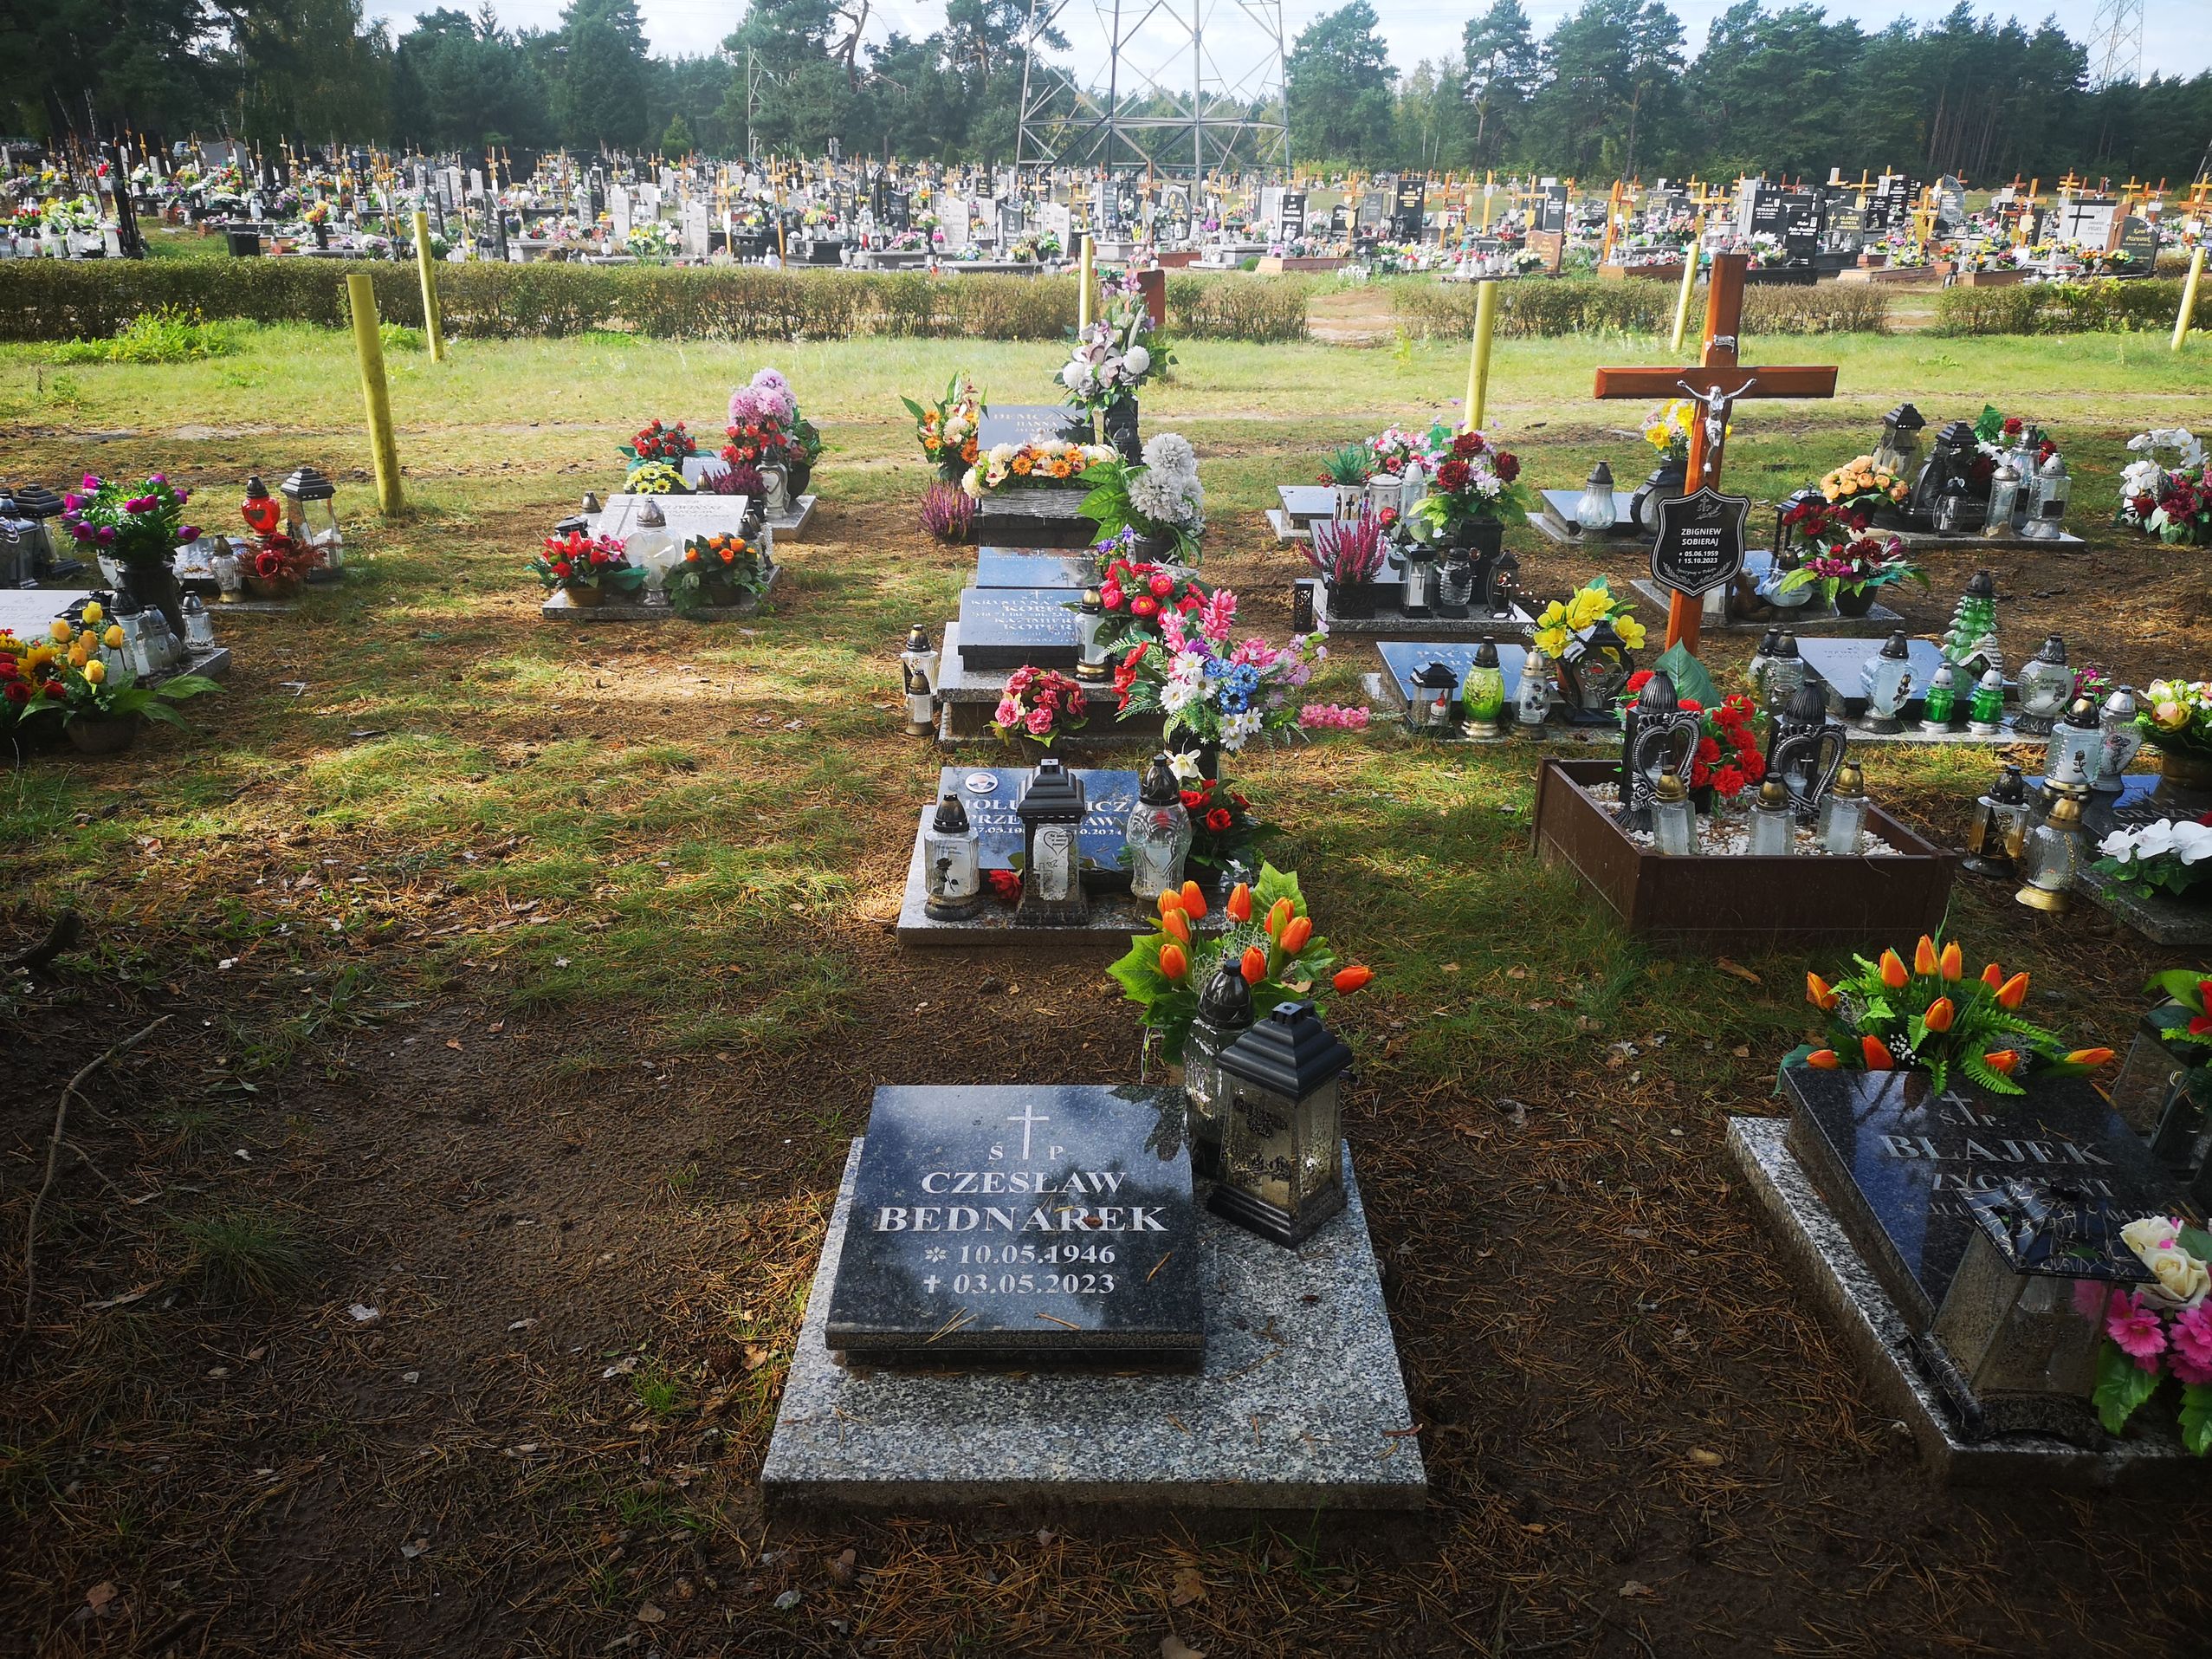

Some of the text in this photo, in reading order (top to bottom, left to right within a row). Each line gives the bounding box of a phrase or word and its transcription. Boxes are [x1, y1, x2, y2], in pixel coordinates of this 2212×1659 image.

[1681, 538, 1718, 547] SOBIERAJ
[1050, 1145, 1064, 1160] P
[1879, 1134, 2115, 1166] BŁAJEK
[921, 1171, 1127, 1194] CZESŁAW
[873, 1206, 1169, 1232] BEDNAREK
[957, 1244, 1116, 1265] 10.05.1946
[953, 1273, 1115, 1294] 03.05.2023
